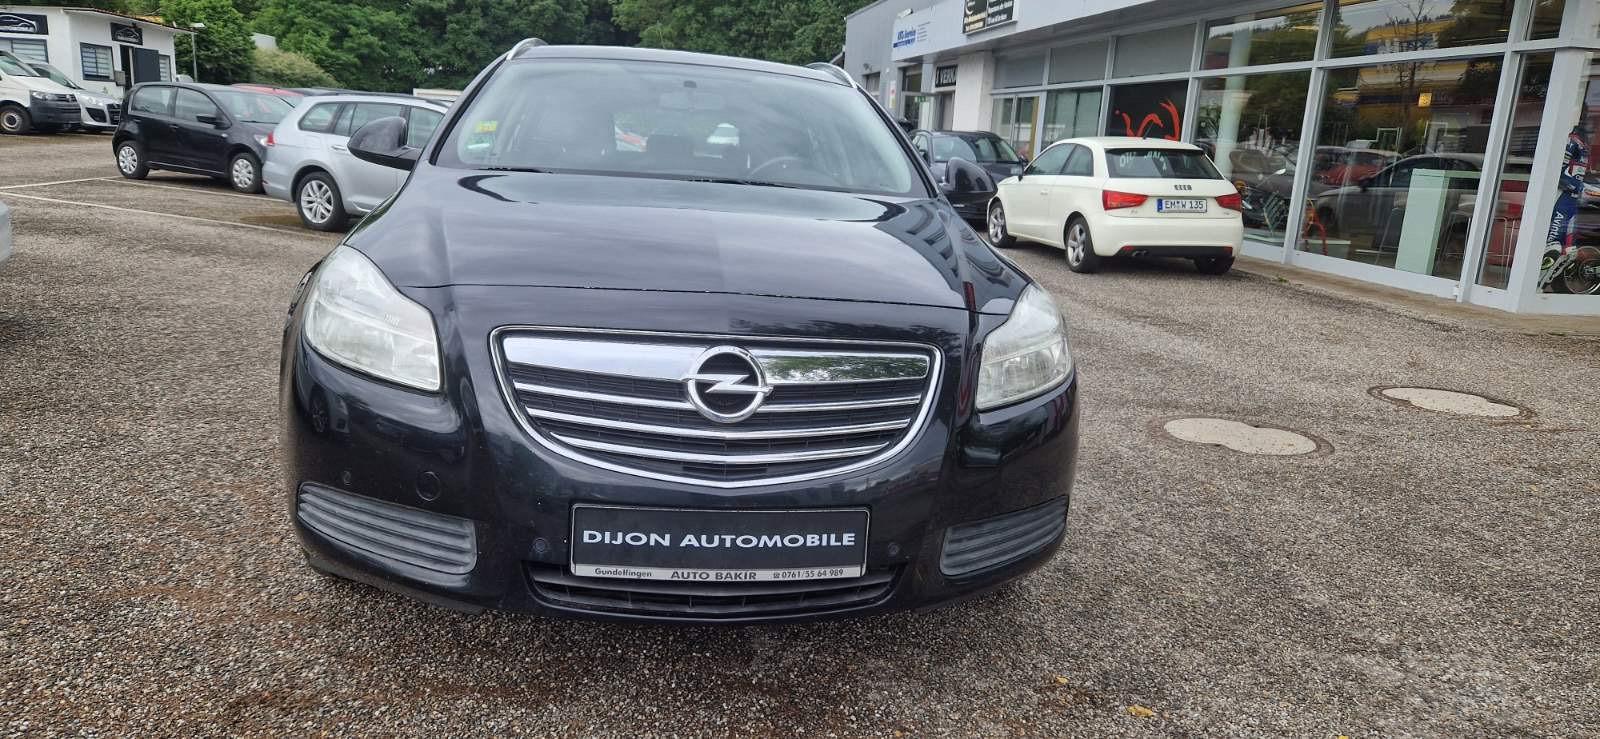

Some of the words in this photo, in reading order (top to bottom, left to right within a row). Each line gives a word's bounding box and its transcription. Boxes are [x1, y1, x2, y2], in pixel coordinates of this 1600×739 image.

[1165, 200, 1176, 209] EM
[1181, 200, 1187, 209] W
[1190, 200, 1203, 209] 135
[583, 530, 671, 547] DIJON
[680, 532, 856, 548] AUTOMOBILE
[594, 567, 652, 578] Gundelfingen
[670, 570, 710, 580] AUTO
[715, 571, 757, 581] BAKIR
[817, 569, 828, 578] 64
[829, 568, 844, 577] 989
